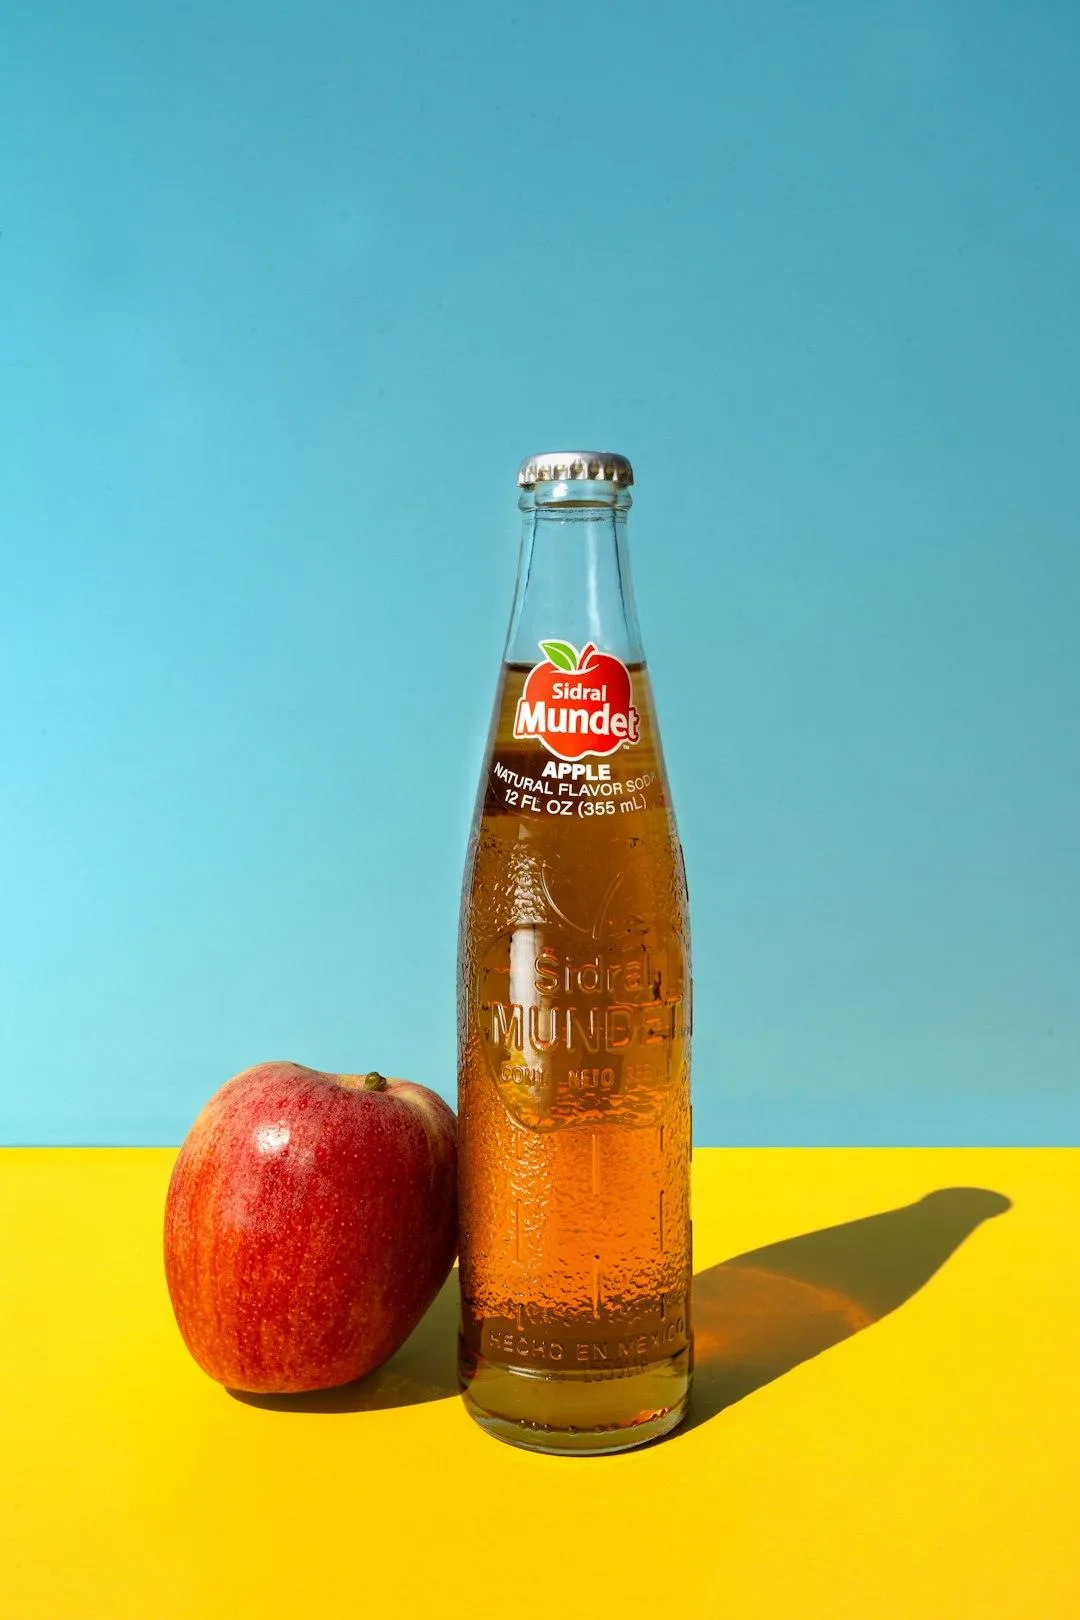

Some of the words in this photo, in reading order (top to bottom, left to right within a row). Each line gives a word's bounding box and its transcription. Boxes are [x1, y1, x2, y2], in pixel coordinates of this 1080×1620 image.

[552, 682, 607, 702] Sidral
[516, 700, 638, 740] Mundet
[493, 761, 554, 795] NATURAL
[558, 782, 623, 797] FLAVOR
[625, 771, 657, 793] SODA
[541, 761, 612, 781] APPLE
[503, 788, 517, 806] 12
[520, 794, 541, 812] FL
[546, 799, 573, 816] OZ
[577, 801, 616, 819] (355
[620, 793, 648, 813] mL)
[488, 1329, 566, 1361] HECHO
[576, 1343, 608, 1362] EN
[618, 1317, 685, 1358] MEXICO
